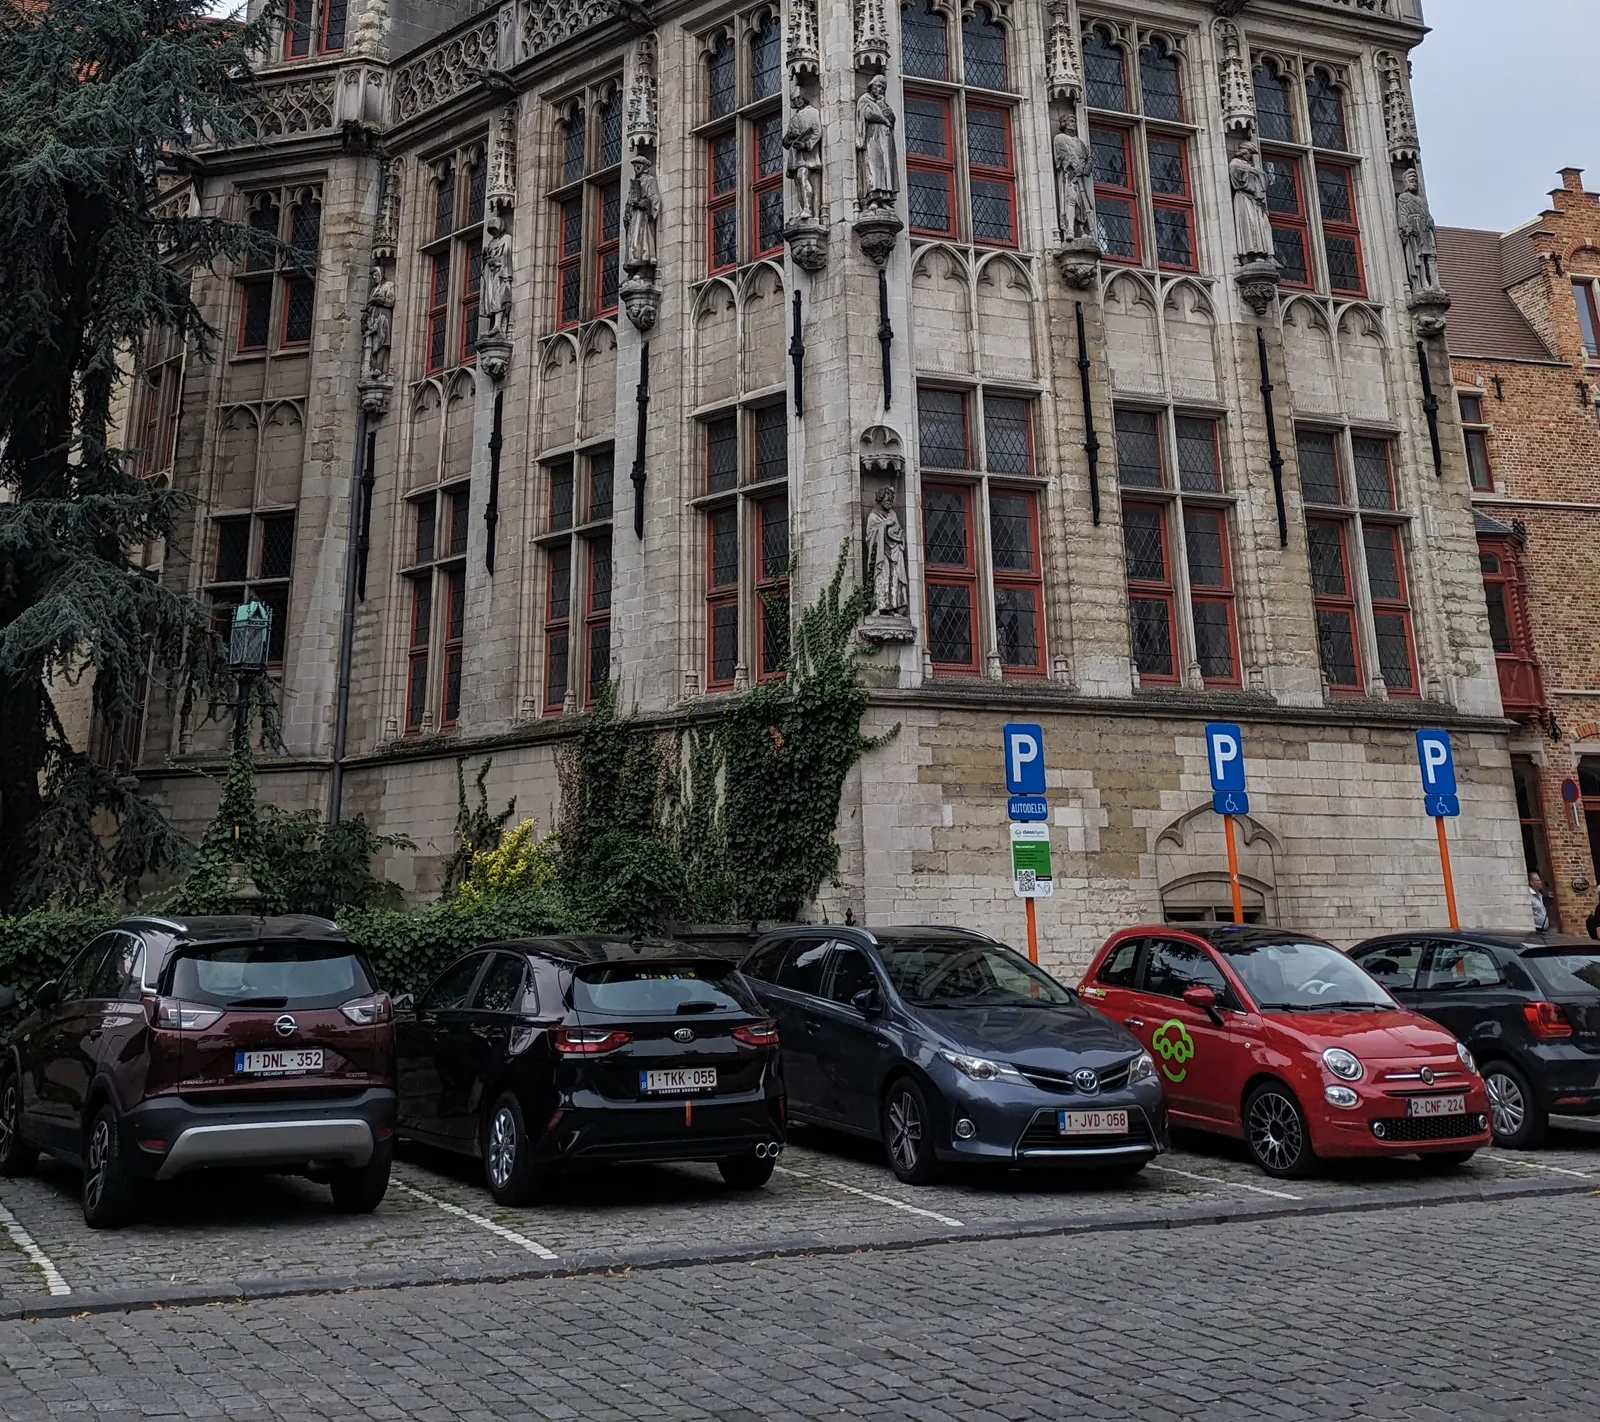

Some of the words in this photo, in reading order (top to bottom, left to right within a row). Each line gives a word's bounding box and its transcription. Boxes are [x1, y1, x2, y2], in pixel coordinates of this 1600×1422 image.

[1011, 734, 1038, 783] P
[1212, 734, 1238, 781] P
[1423, 739, 1447, 784] P
[1011, 803, 1047, 814] AUTODELEN
[678, 1030, 692, 1039] KIA
